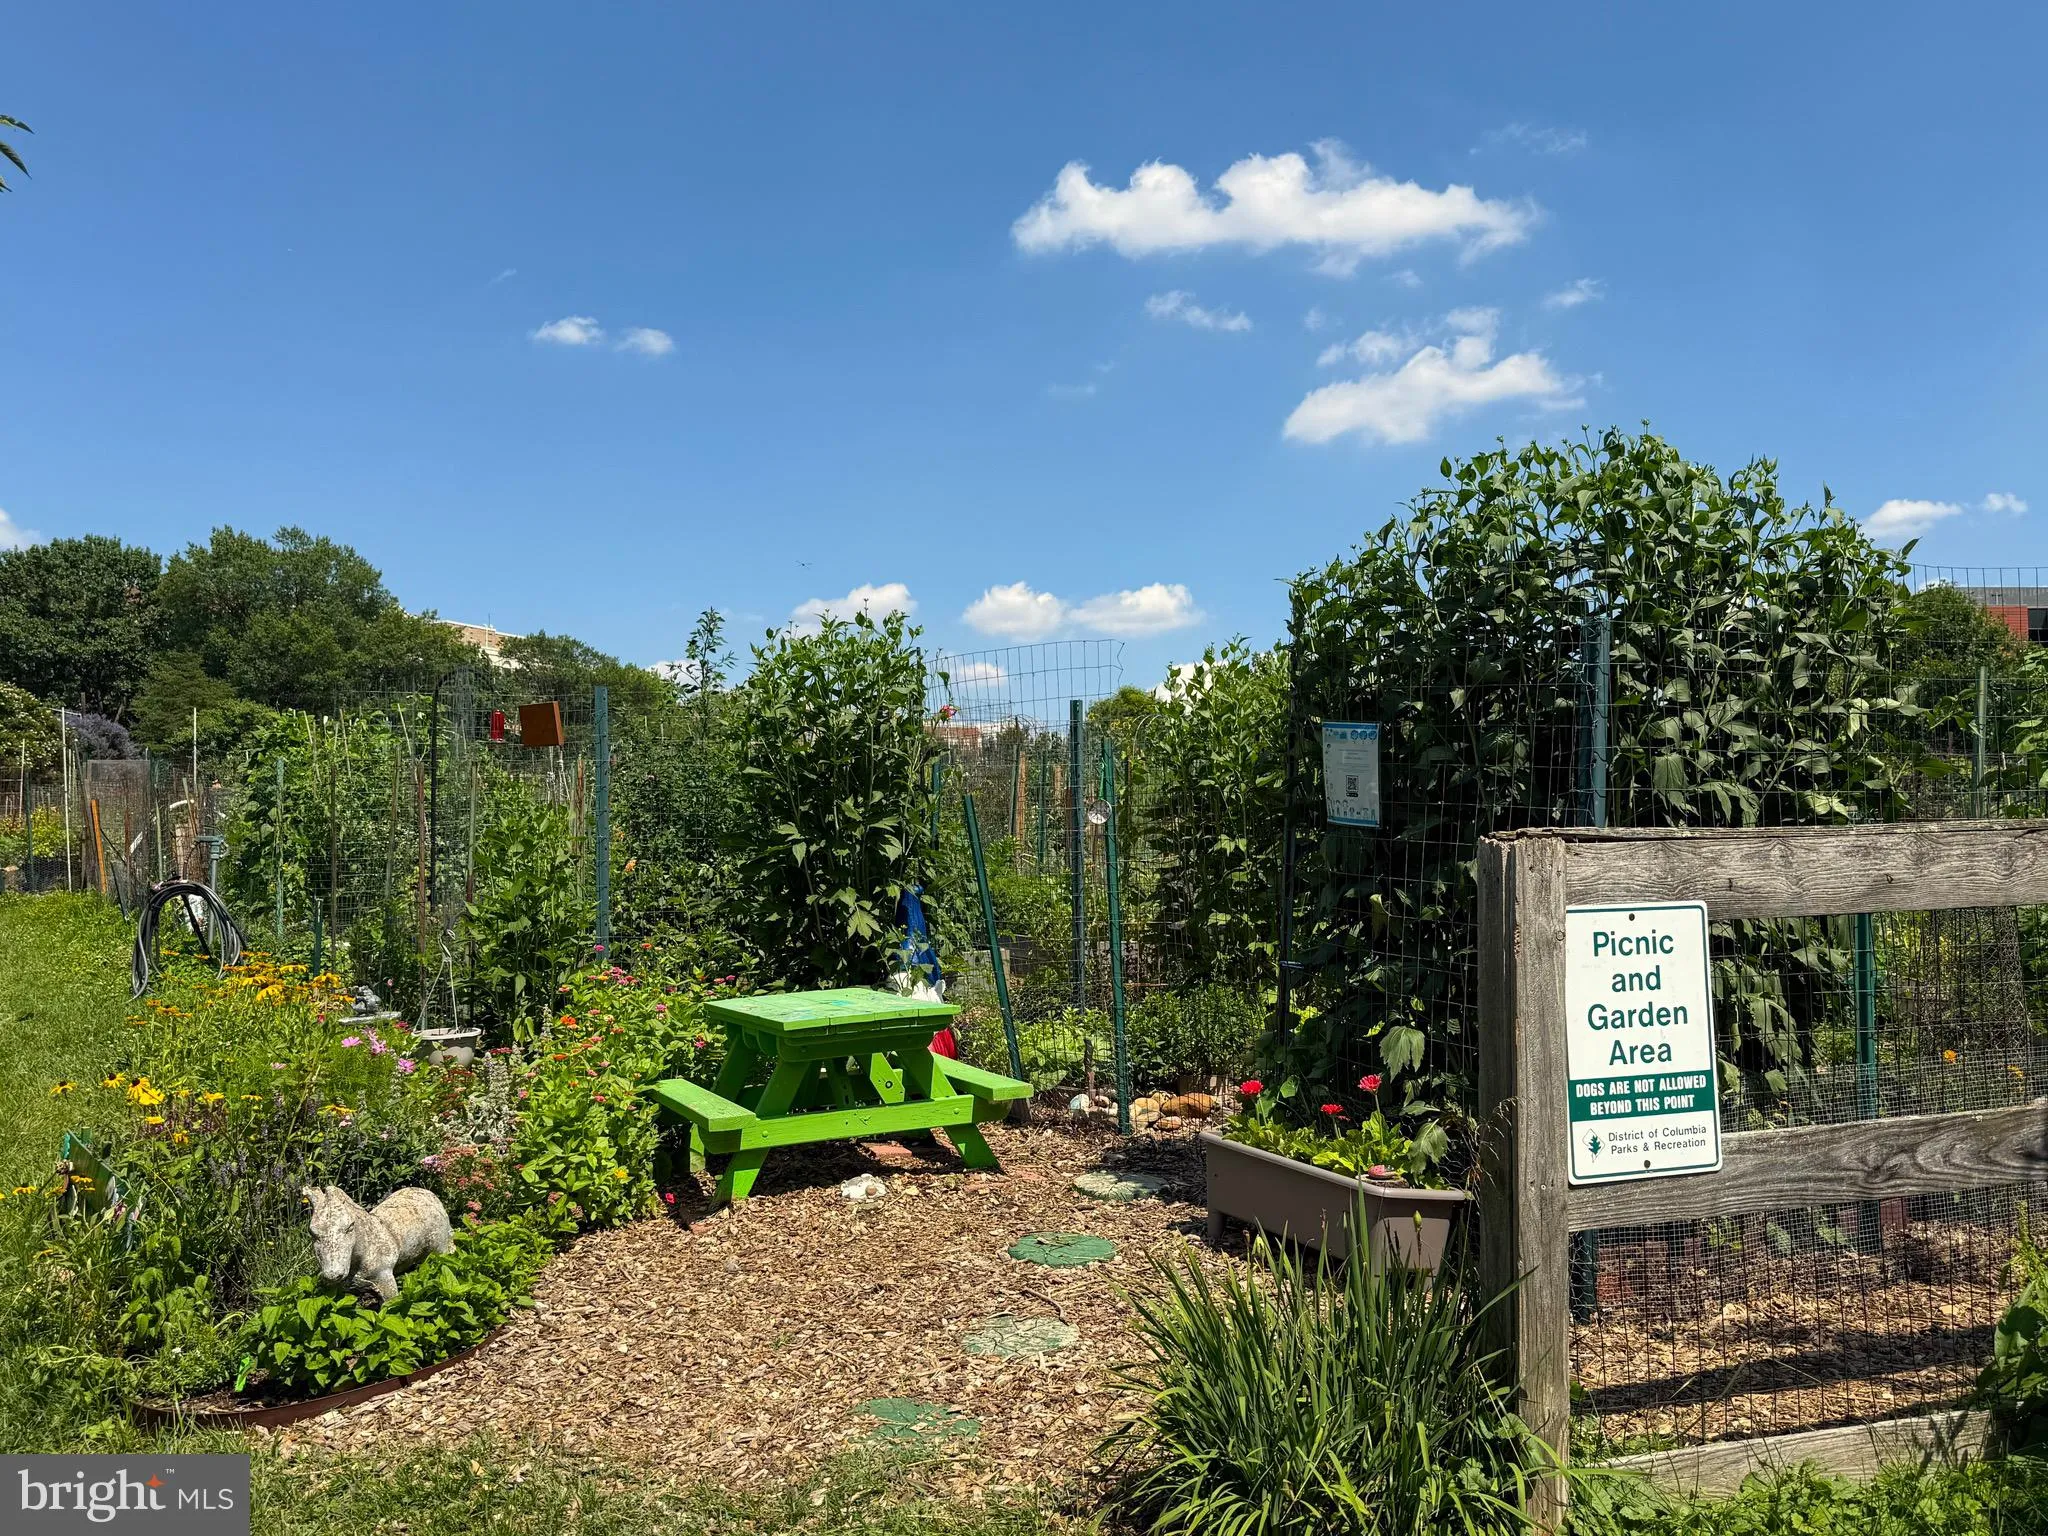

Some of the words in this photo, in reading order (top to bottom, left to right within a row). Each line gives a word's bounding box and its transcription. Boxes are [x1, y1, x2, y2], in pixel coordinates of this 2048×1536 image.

[1593, 929, 1674, 957] Picnic
[1611, 965, 1661, 992] and
[1587, 1001, 1688, 1031] Garden
[1609, 1040, 1672, 1066] Area
[1576, 1083, 1605, 1097] DOGS
[1609, 1080, 1630, 1095] ARE
[1634, 1079, 1655, 1093] NOT
[1659, 1075, 1706, 1091] ALLOWED
[1590, 1099, 1632, 1115] BEYOND
[1635, 1097, 1660, 1112] THIS
[1664, 1094, 1695, 1109] POINT
[1608, 1131, 1643, 1142] District
[1648, 1129, 1658, 1138] of
[1662, 1125, 1707, 1137] Columbia
[1611, 1143, 1638, 1154] Parks
[1643, 1142, 1649, 1151] &
[1654, 1138, 1706, 1150] Recreation
